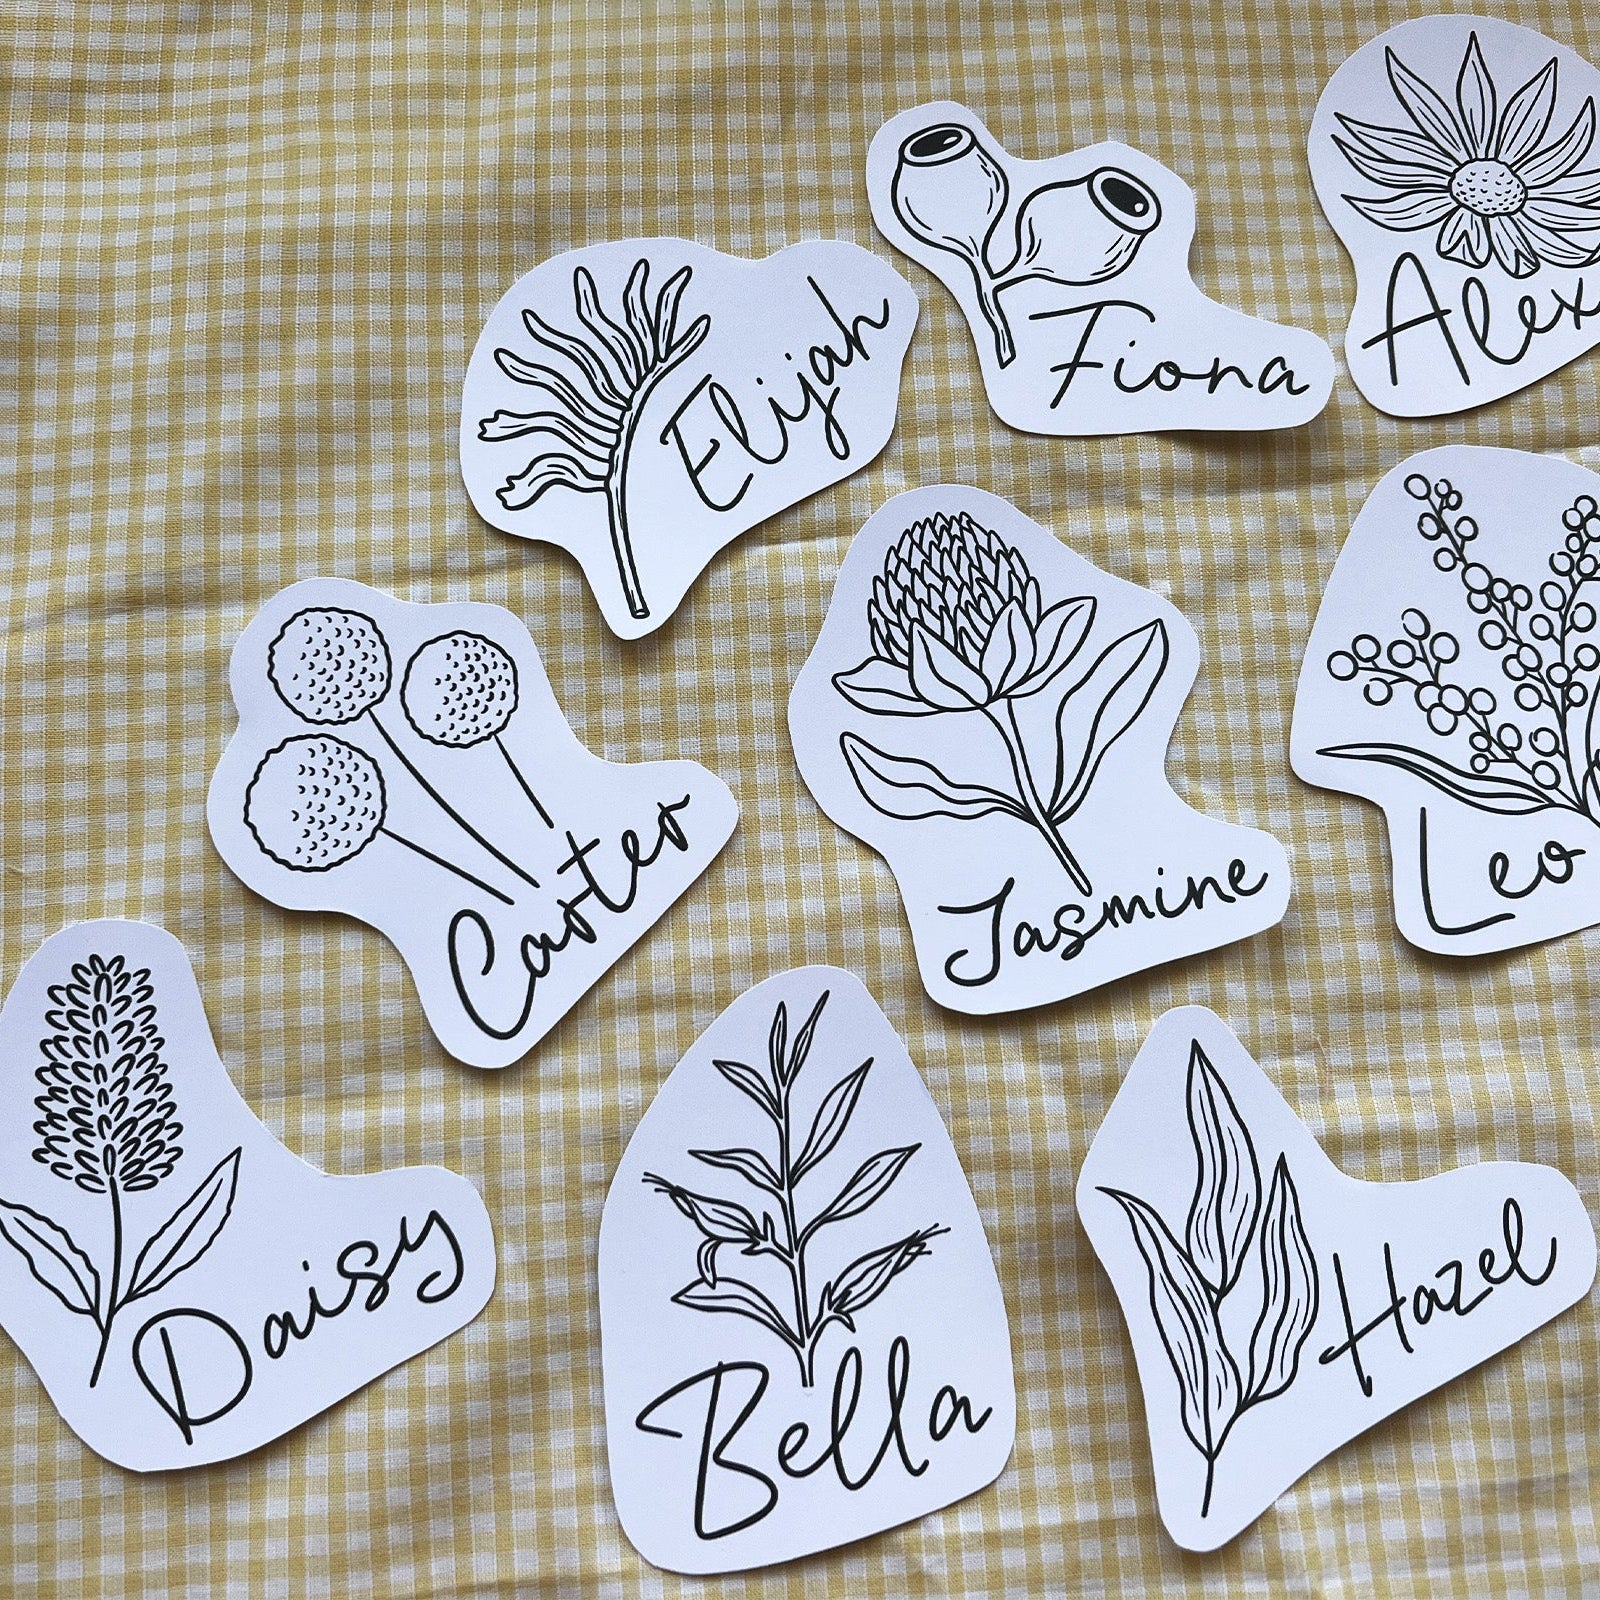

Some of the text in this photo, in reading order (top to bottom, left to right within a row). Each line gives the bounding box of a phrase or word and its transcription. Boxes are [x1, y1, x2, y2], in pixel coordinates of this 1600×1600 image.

[660, 275, 890, 512] Elijah
[1028, 300, 1310, 410] Fiona
[1362, 251, 1600, 388] Alex
[447, 793, 691, 1041] Carter
[937, 858, 1269, 988] Jasmine
[1419, 806, 1587, 936] Leo
[132, 1210, 464, 1446] Daisy
[1318, 1197, 1557, 1398] Hazel
[635, 1335, 993, 1541] Bella
